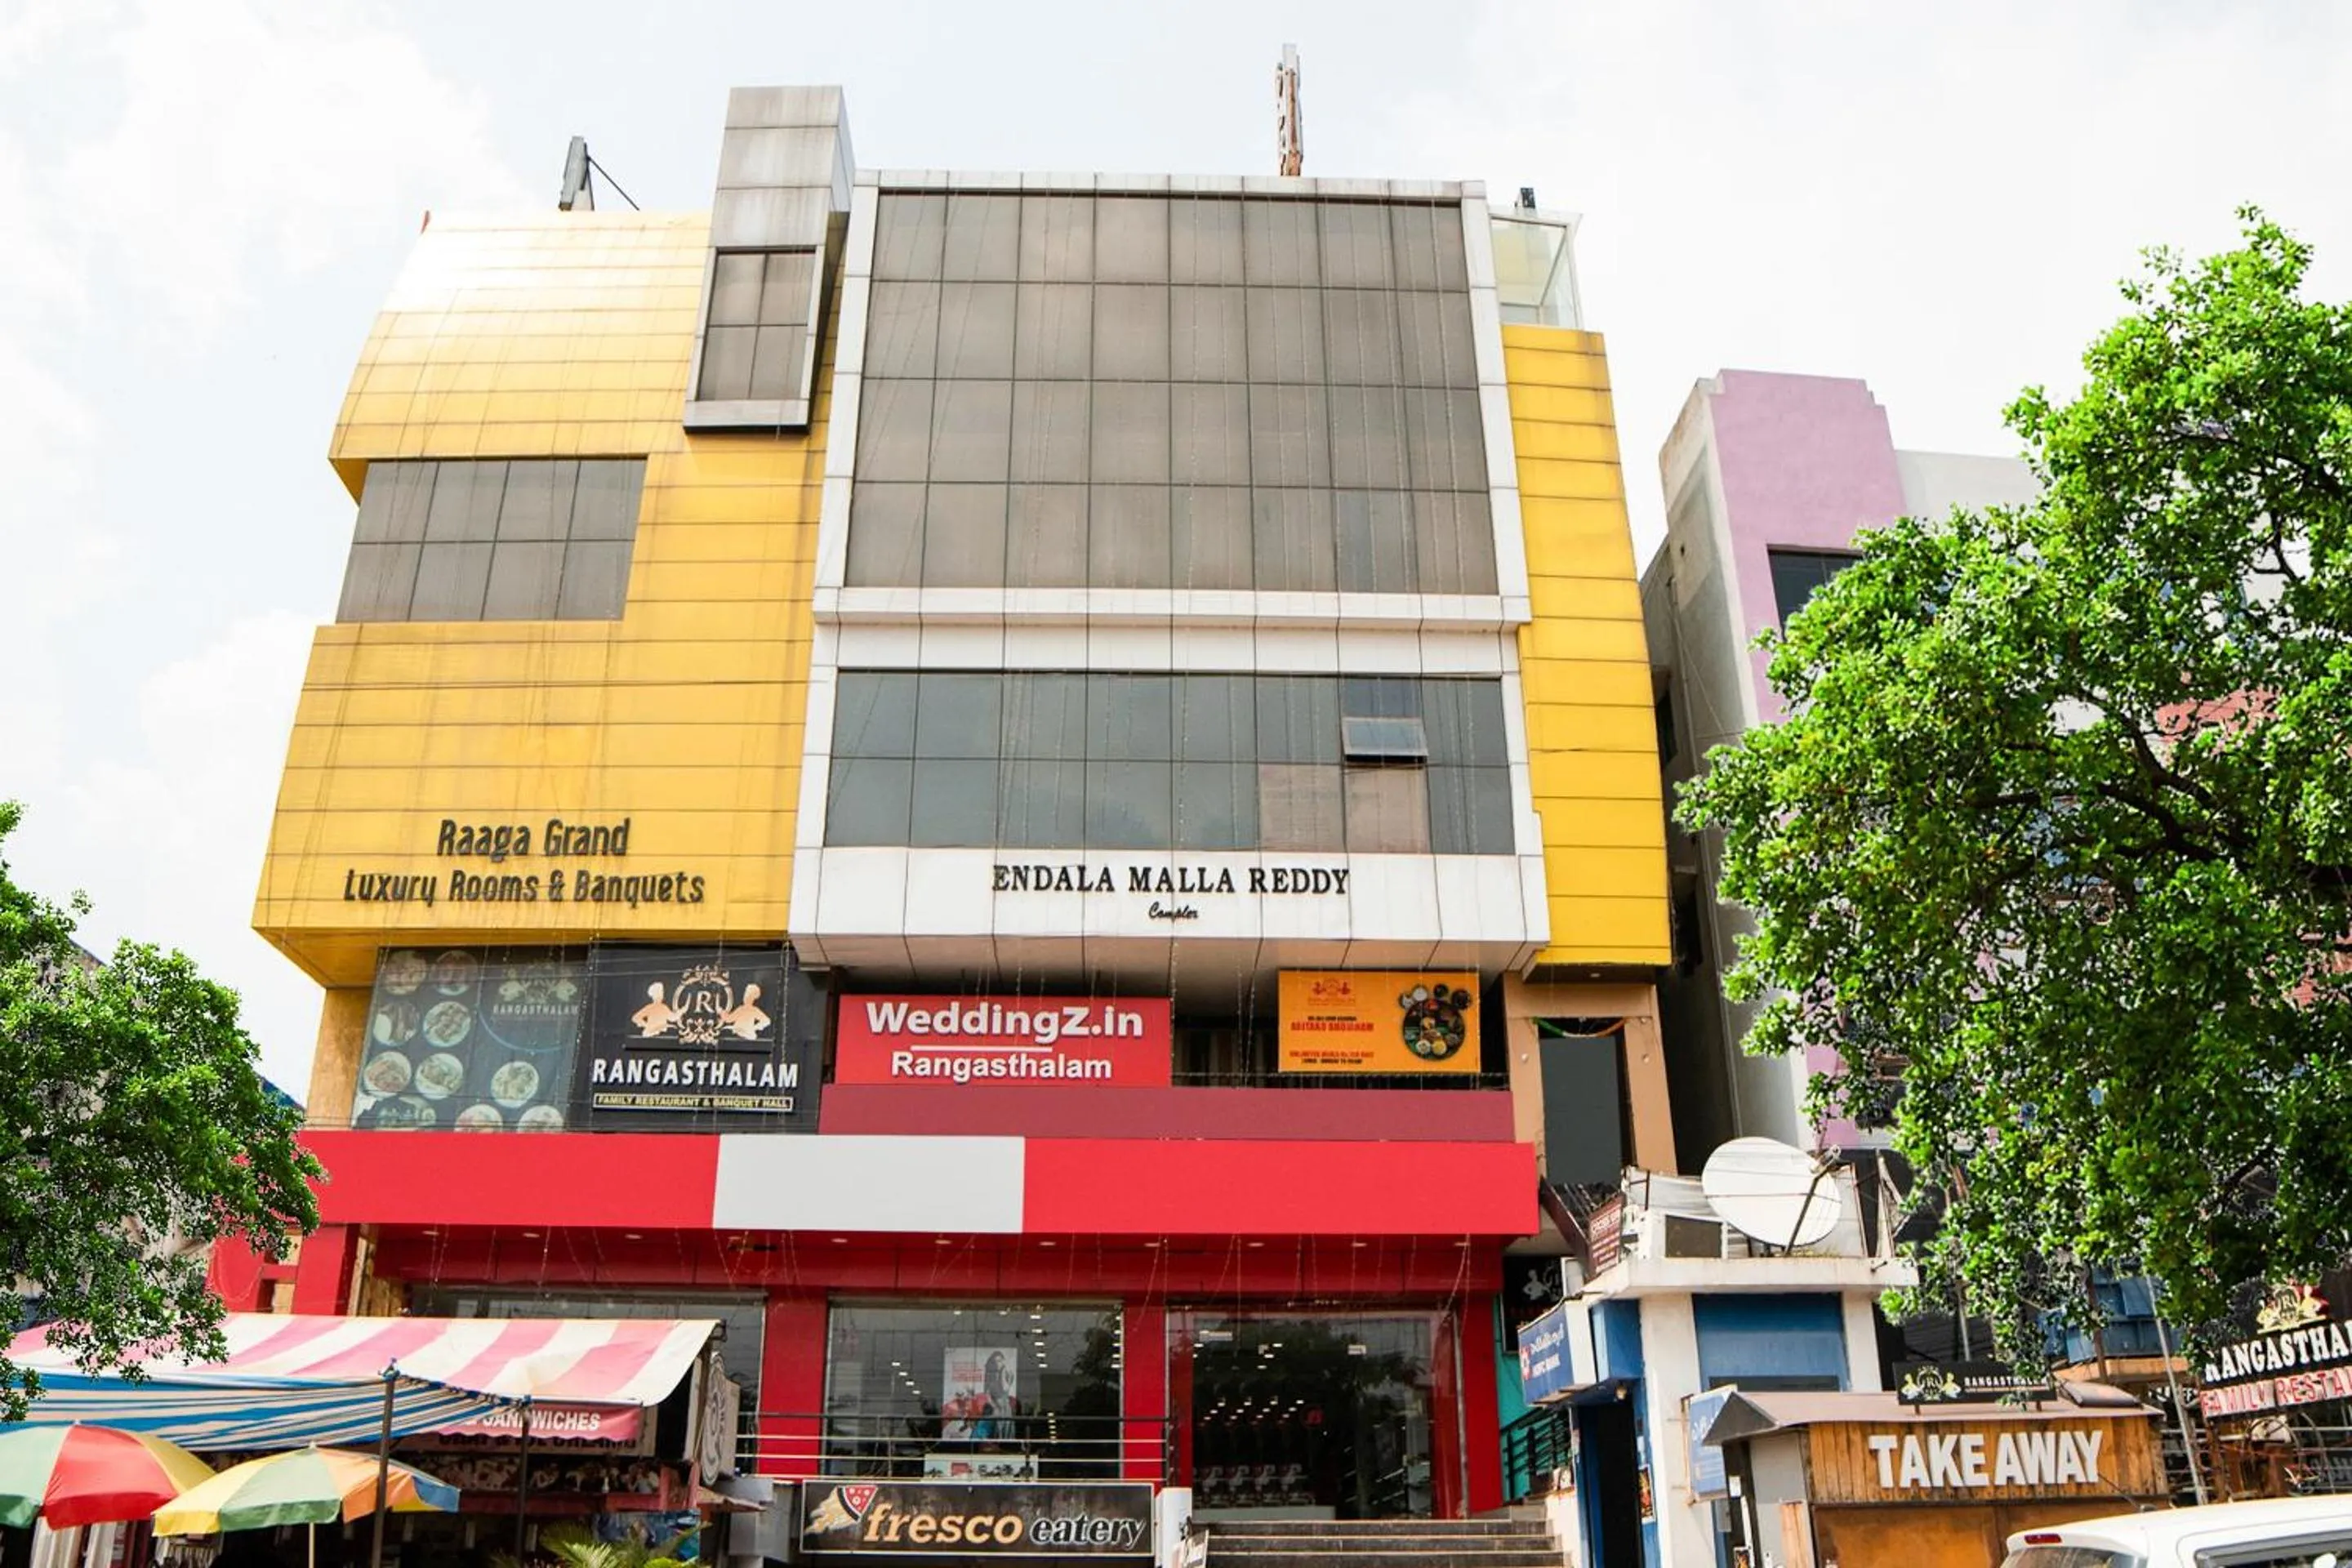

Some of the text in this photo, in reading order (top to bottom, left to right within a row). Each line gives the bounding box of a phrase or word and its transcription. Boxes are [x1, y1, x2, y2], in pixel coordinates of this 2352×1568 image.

[436, 817, 631, 863] Raaga Grand
[343, 868, 706, 909] Luxury Rooms & Banquets
[992, 864, 1349, 894] ENDALA MALLA REDDY
[492, 1004, 579, 1015] RANGASTHALAM
[591, 1058, 799, 1089] RANGASTHALAM
[891, 1050, 1113, 1083] Rangasthalam
[598, 1095, 634, 1105] FAMILY
[636, 1096, 700, 1107] RESTAURANT
[763, 1098, 787, 1108] HALL
[2205, 1320, 2352, 1383] ANGASTHA
[2200, 1381, 2269, 1415] FAMILY
[1868, 1430, 2104, 1488] TAKE AWAY
[862, 1502, 1147, 1551] fresco eatery
